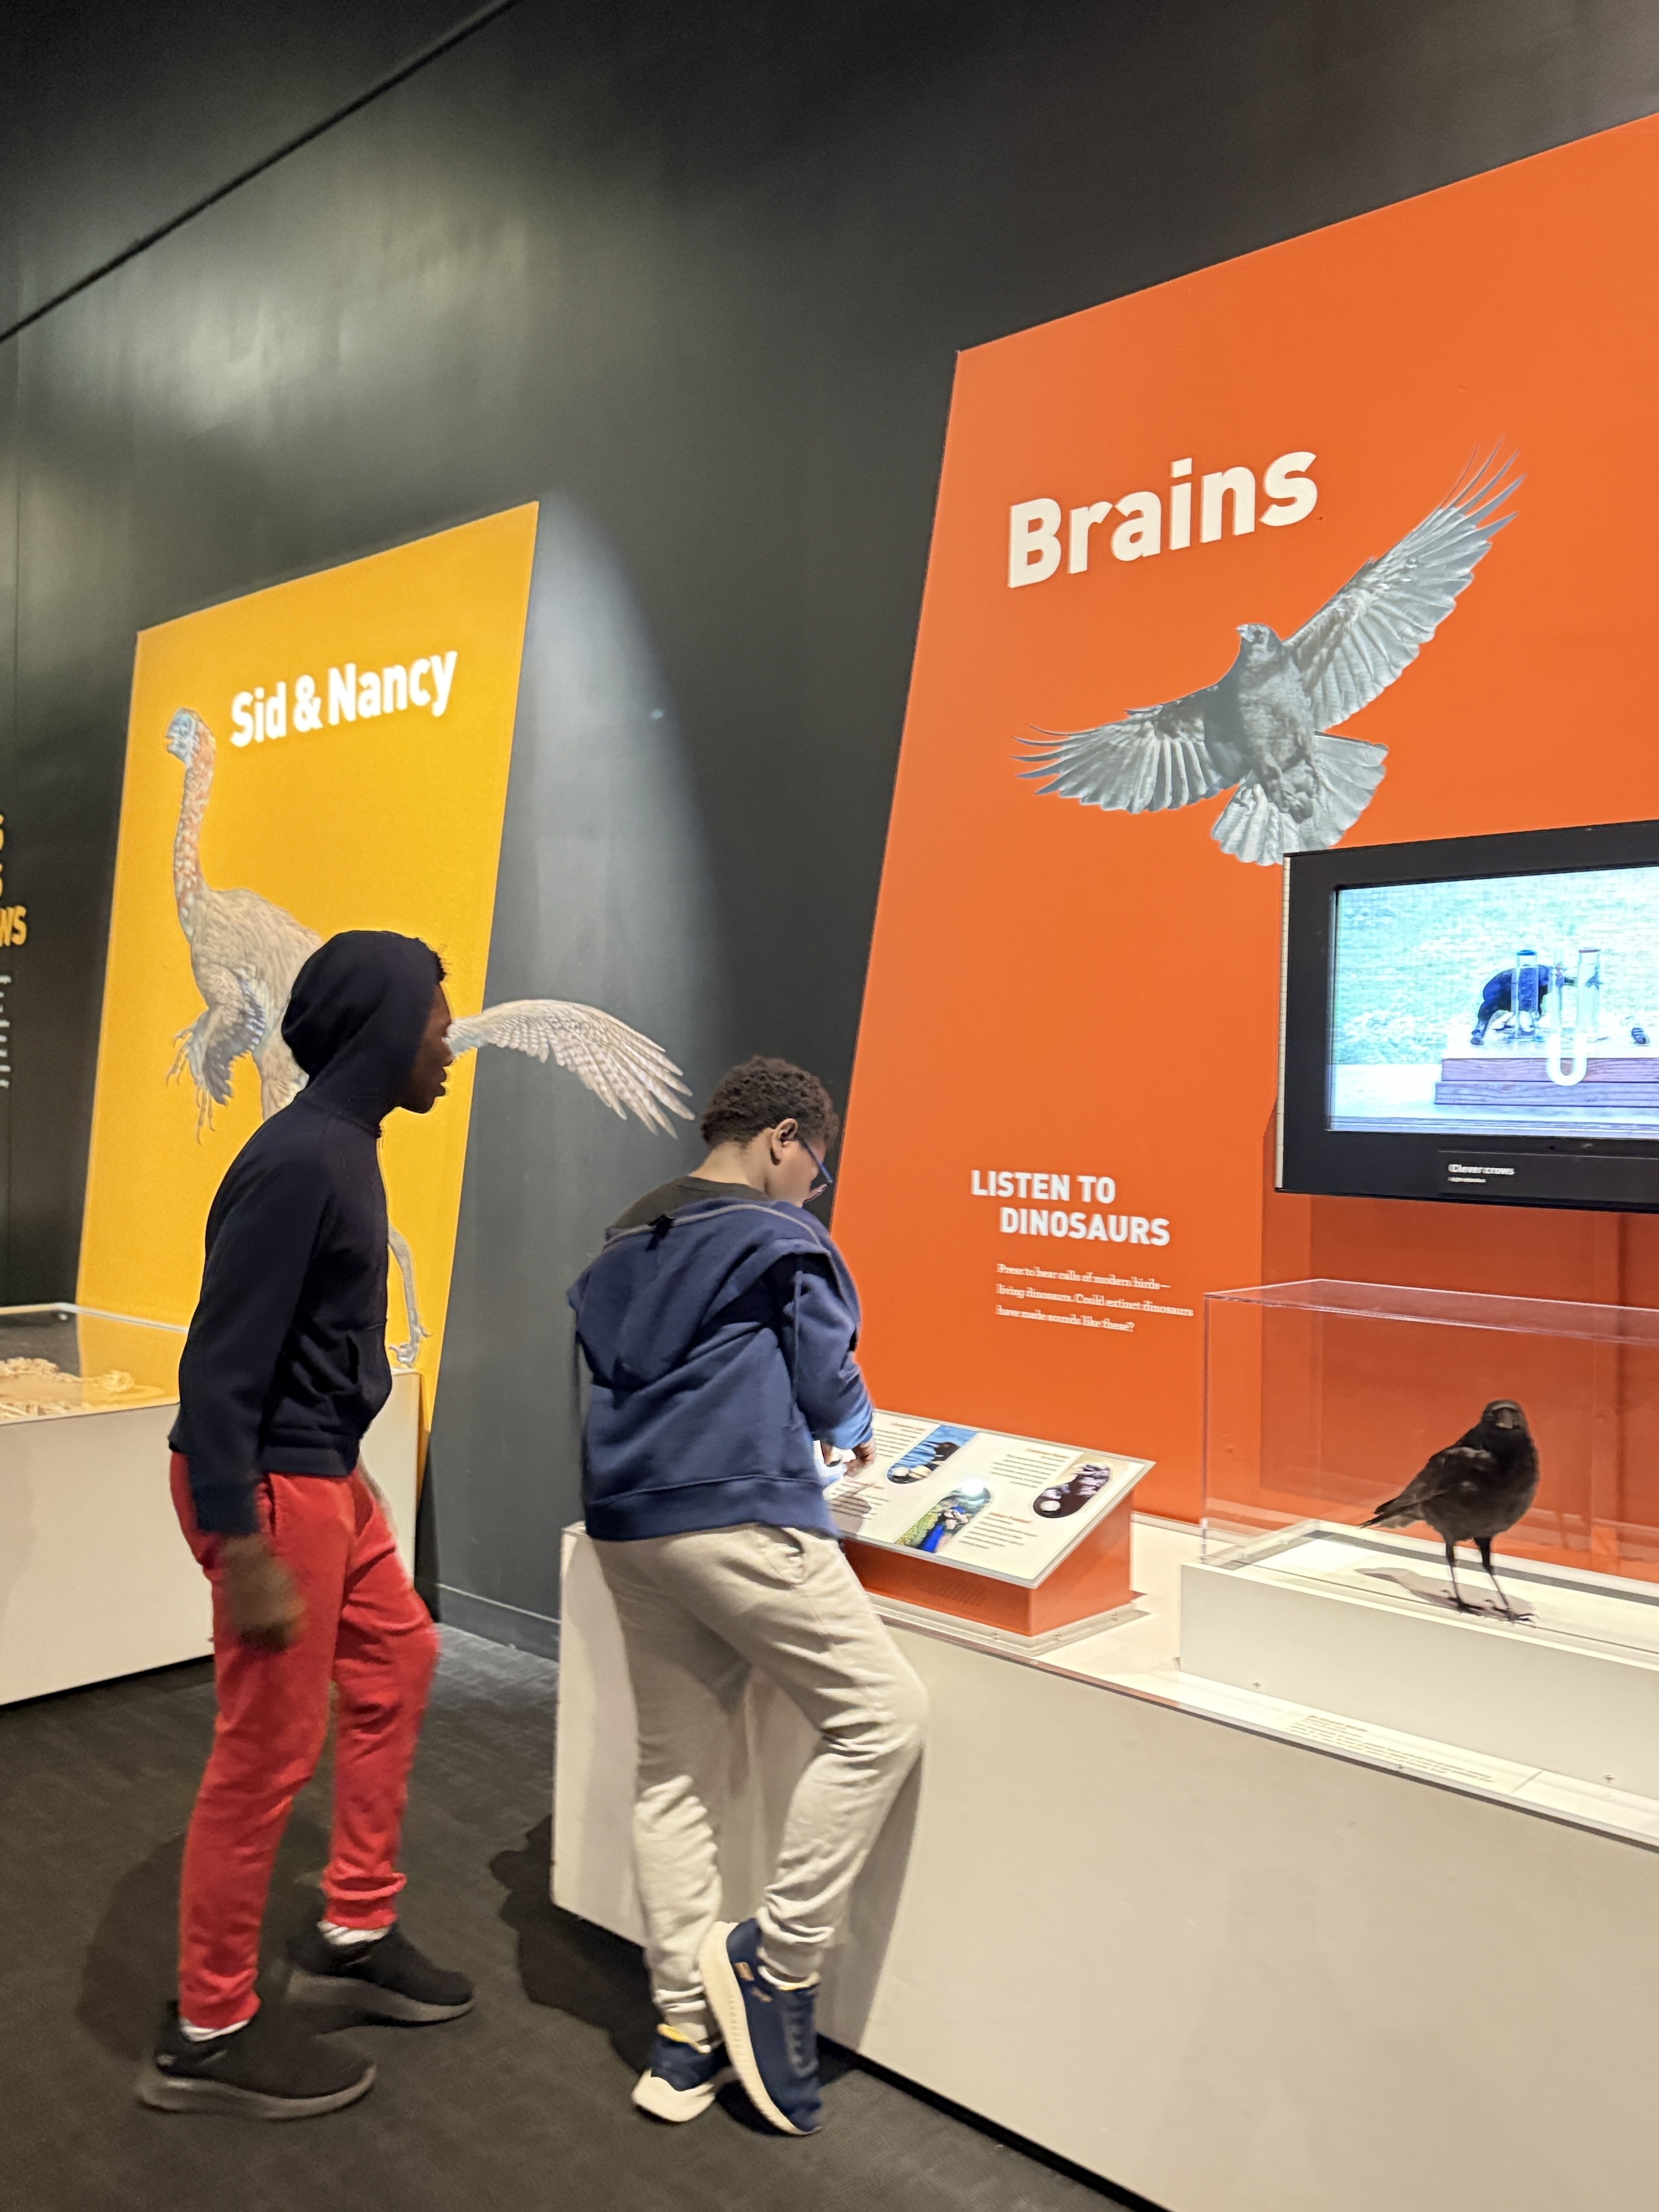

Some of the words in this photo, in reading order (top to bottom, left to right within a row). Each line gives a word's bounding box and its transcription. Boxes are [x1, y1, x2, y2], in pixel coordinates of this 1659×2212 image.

[1007, 451, 1318, 588] Brains
[229, 680, 287, 748] Sid
[293, 674, 324, 733] &
[328, 650, 458, 726] Nancy
[1448, 1164, 1482, 1174] Clever
[971, 1170, 1070, 1201] LISTEN
[1076, 1175, 1116, 1204] TO
[1000, 1207, 1170, 1246] DINOSAURS
[996, 1263, 1024, 1276] Press
[1024, 1268, 1035, 1277] to
[1034, 1266, 1057, 1279] hear
[1057, 1269, 1081, 1282] calls
[1082, 1272, 1093, 1283] of
[1091, 1274, 1132, 1287] modern
[996, 1283, 1025, 1299] living
[1025, 1287, 1074, 1302] dinosaurs.
[1074, 1293, 1104, 1306] Could
[1105, 1298, 1141, 1311] extinct
[1141, 1300, 1194, 1317] dinosaurs
[996, 1305, 1020, 1318] have
[1020, 1309, 1047, 1321] made
[1047, 1313, 1081, 1325] sounds
[1080, 1314, 1101, 1328] like
[1101, 1318, 1135, 1333] these?
